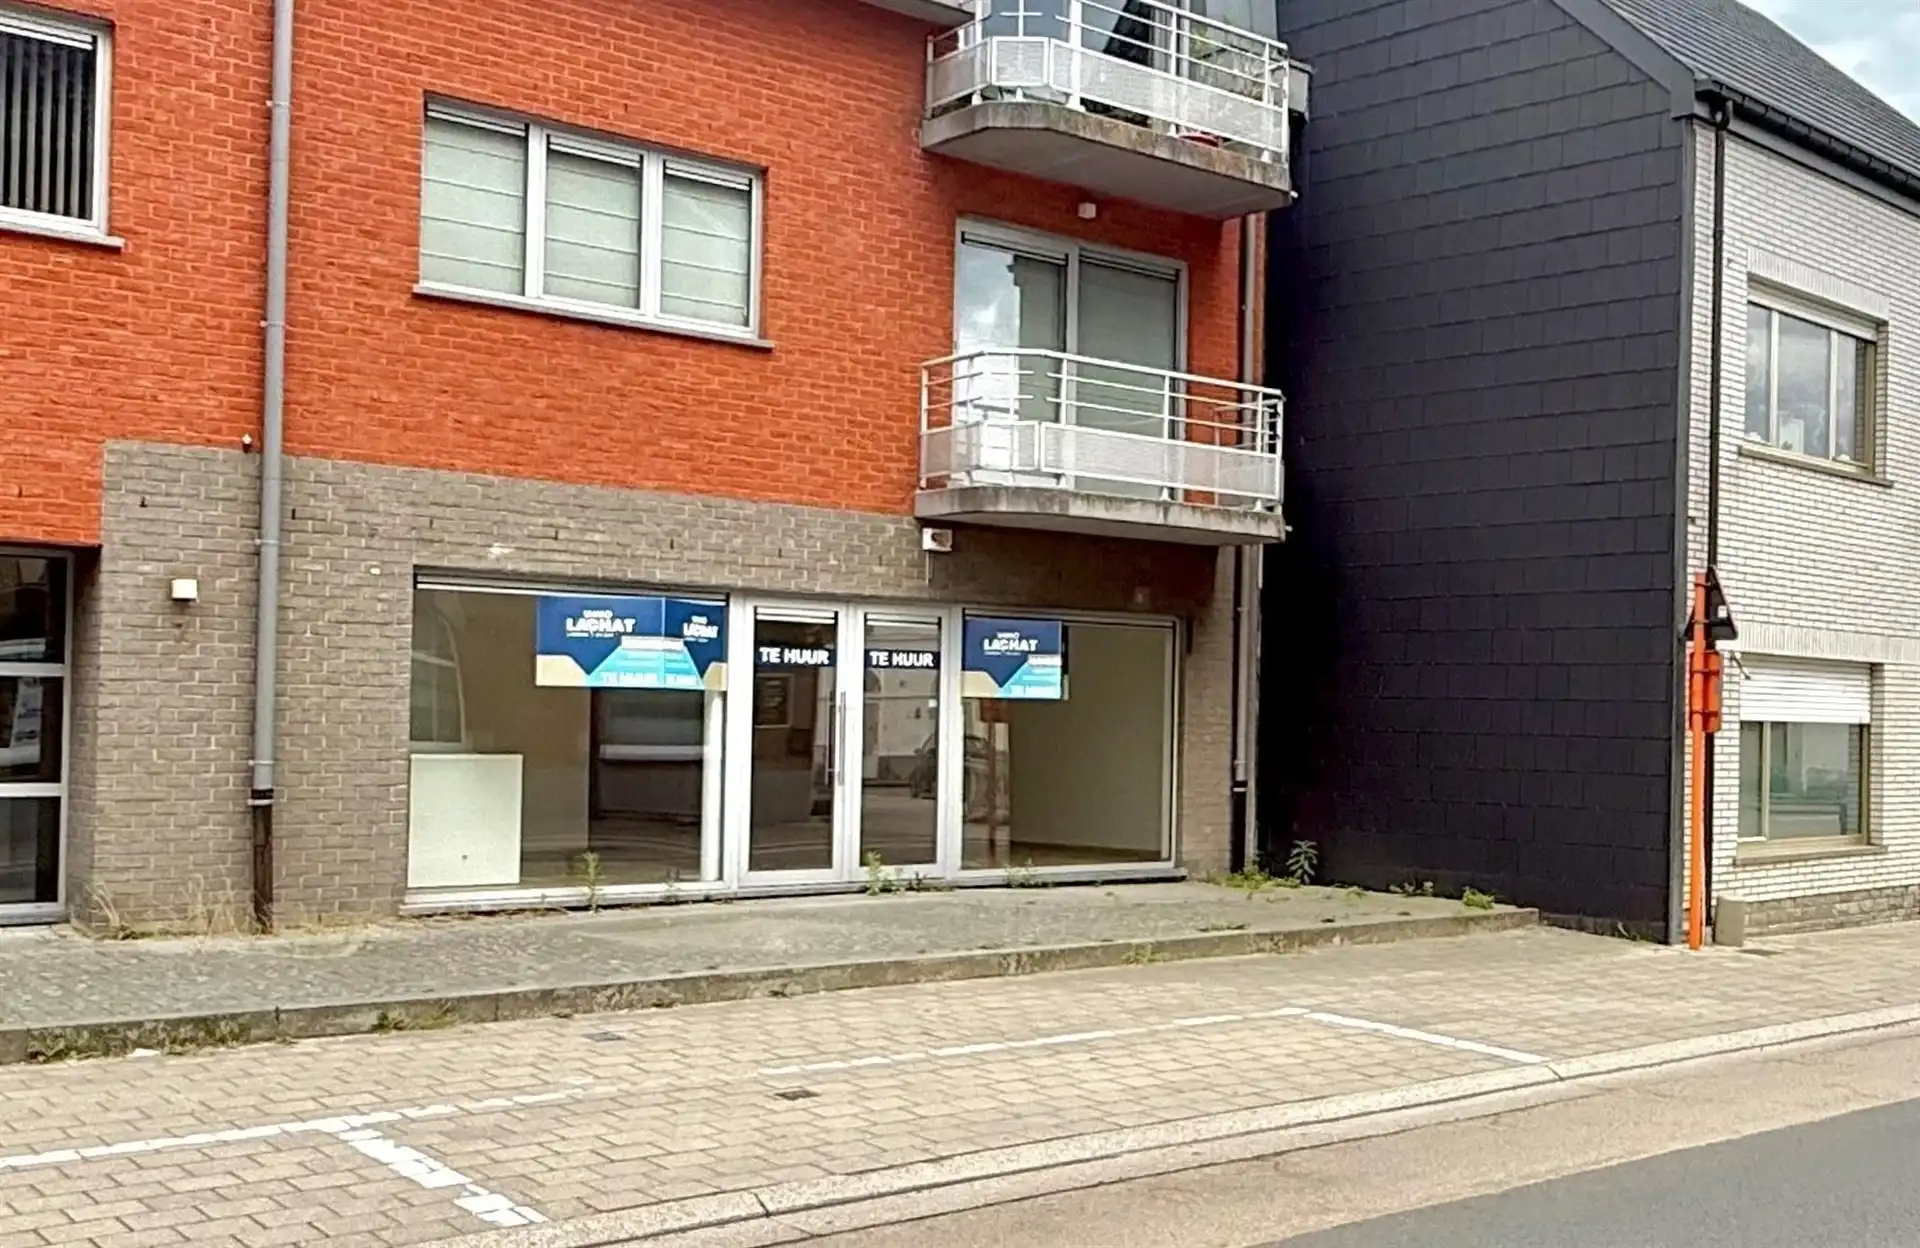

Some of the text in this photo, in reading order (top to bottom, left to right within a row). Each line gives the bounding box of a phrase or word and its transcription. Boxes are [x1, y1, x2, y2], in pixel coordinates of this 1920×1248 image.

[759, 647, 829, 665] TE HUUR
[869, 651, 934, 667] TE HUUR
